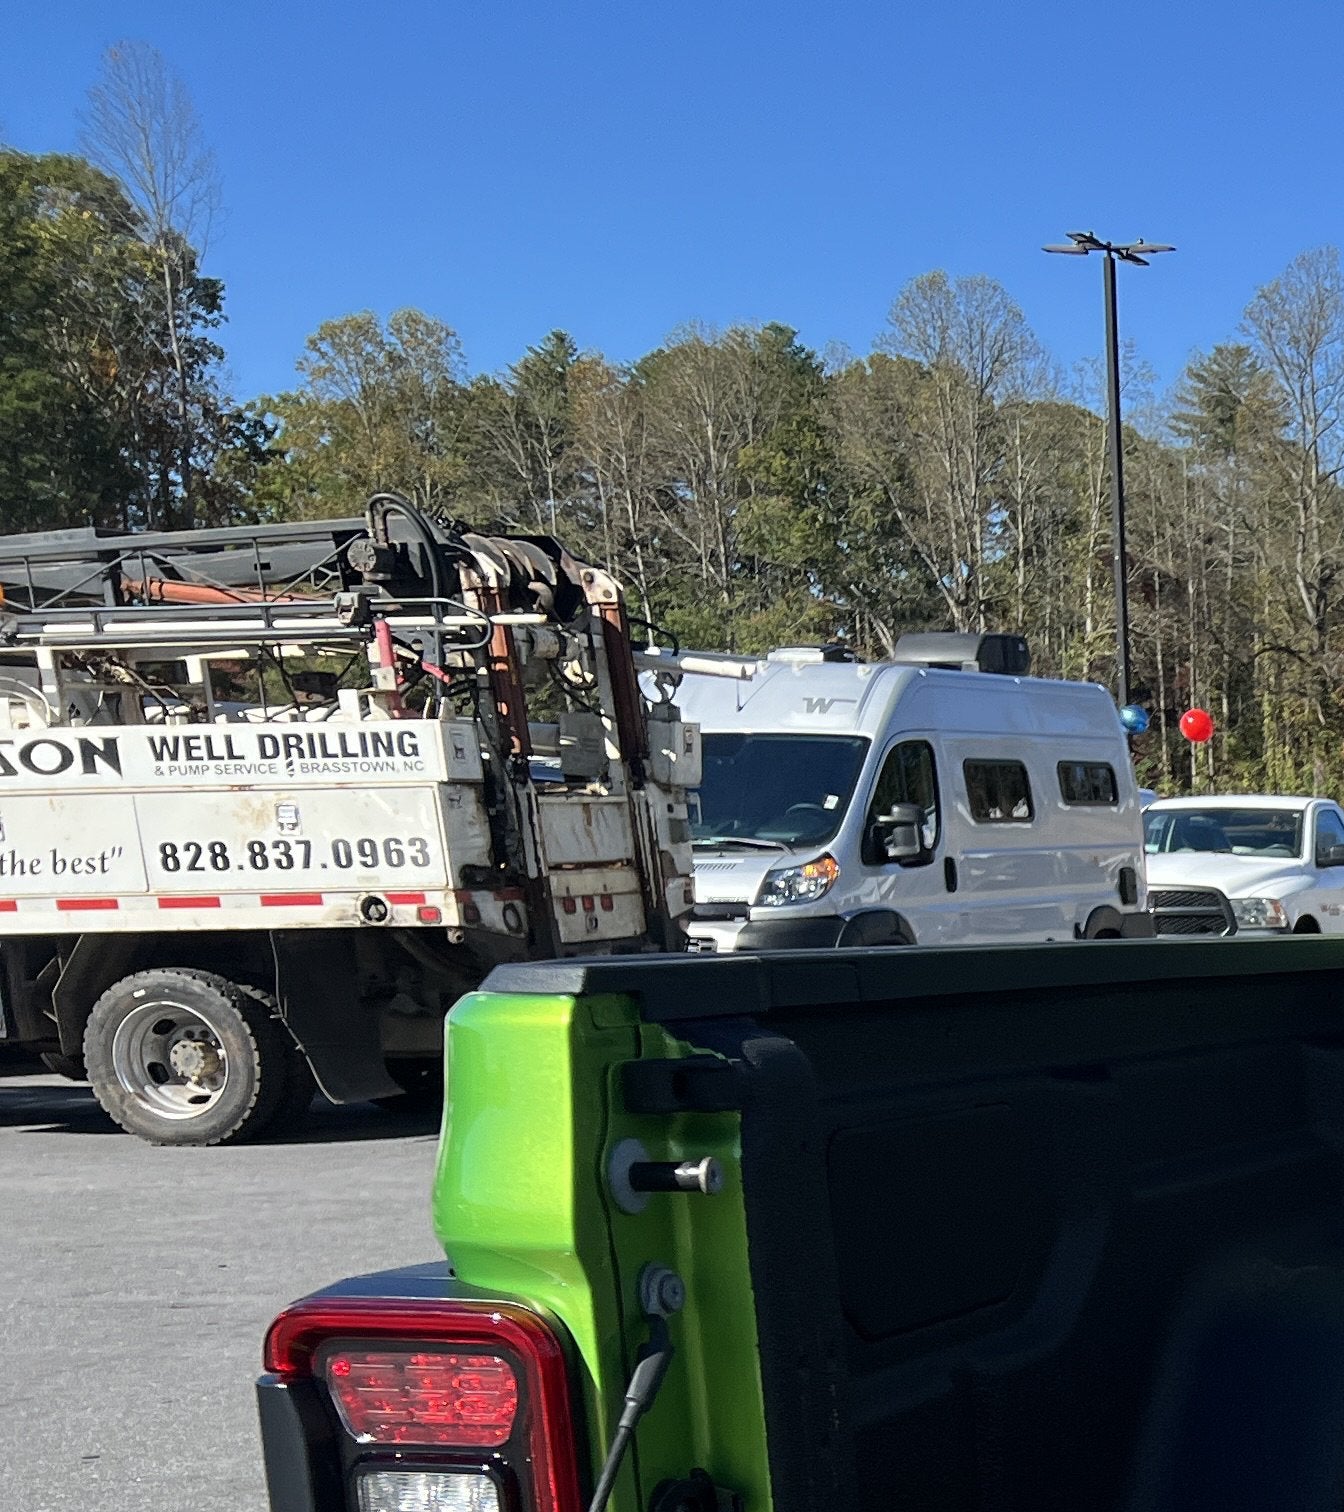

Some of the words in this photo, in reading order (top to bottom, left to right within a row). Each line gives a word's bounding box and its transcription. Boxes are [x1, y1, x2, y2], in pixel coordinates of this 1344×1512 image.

[147, 734, 245, 762] WELL
[256, 730, 420, 760] DRILLING
[154, 765, 165, 777] &
[168, 764, 210, 776] PUMP
[214, 763, 278, 775] SERVICE
[300, 761, 400, 774] BRASSTOWN,
[404, 760, 425, 772] NC
[0, 848, 42, 876] the
[52, 846, 123, 876] best"
[159, 837, 431, 873] 828.837.0963
